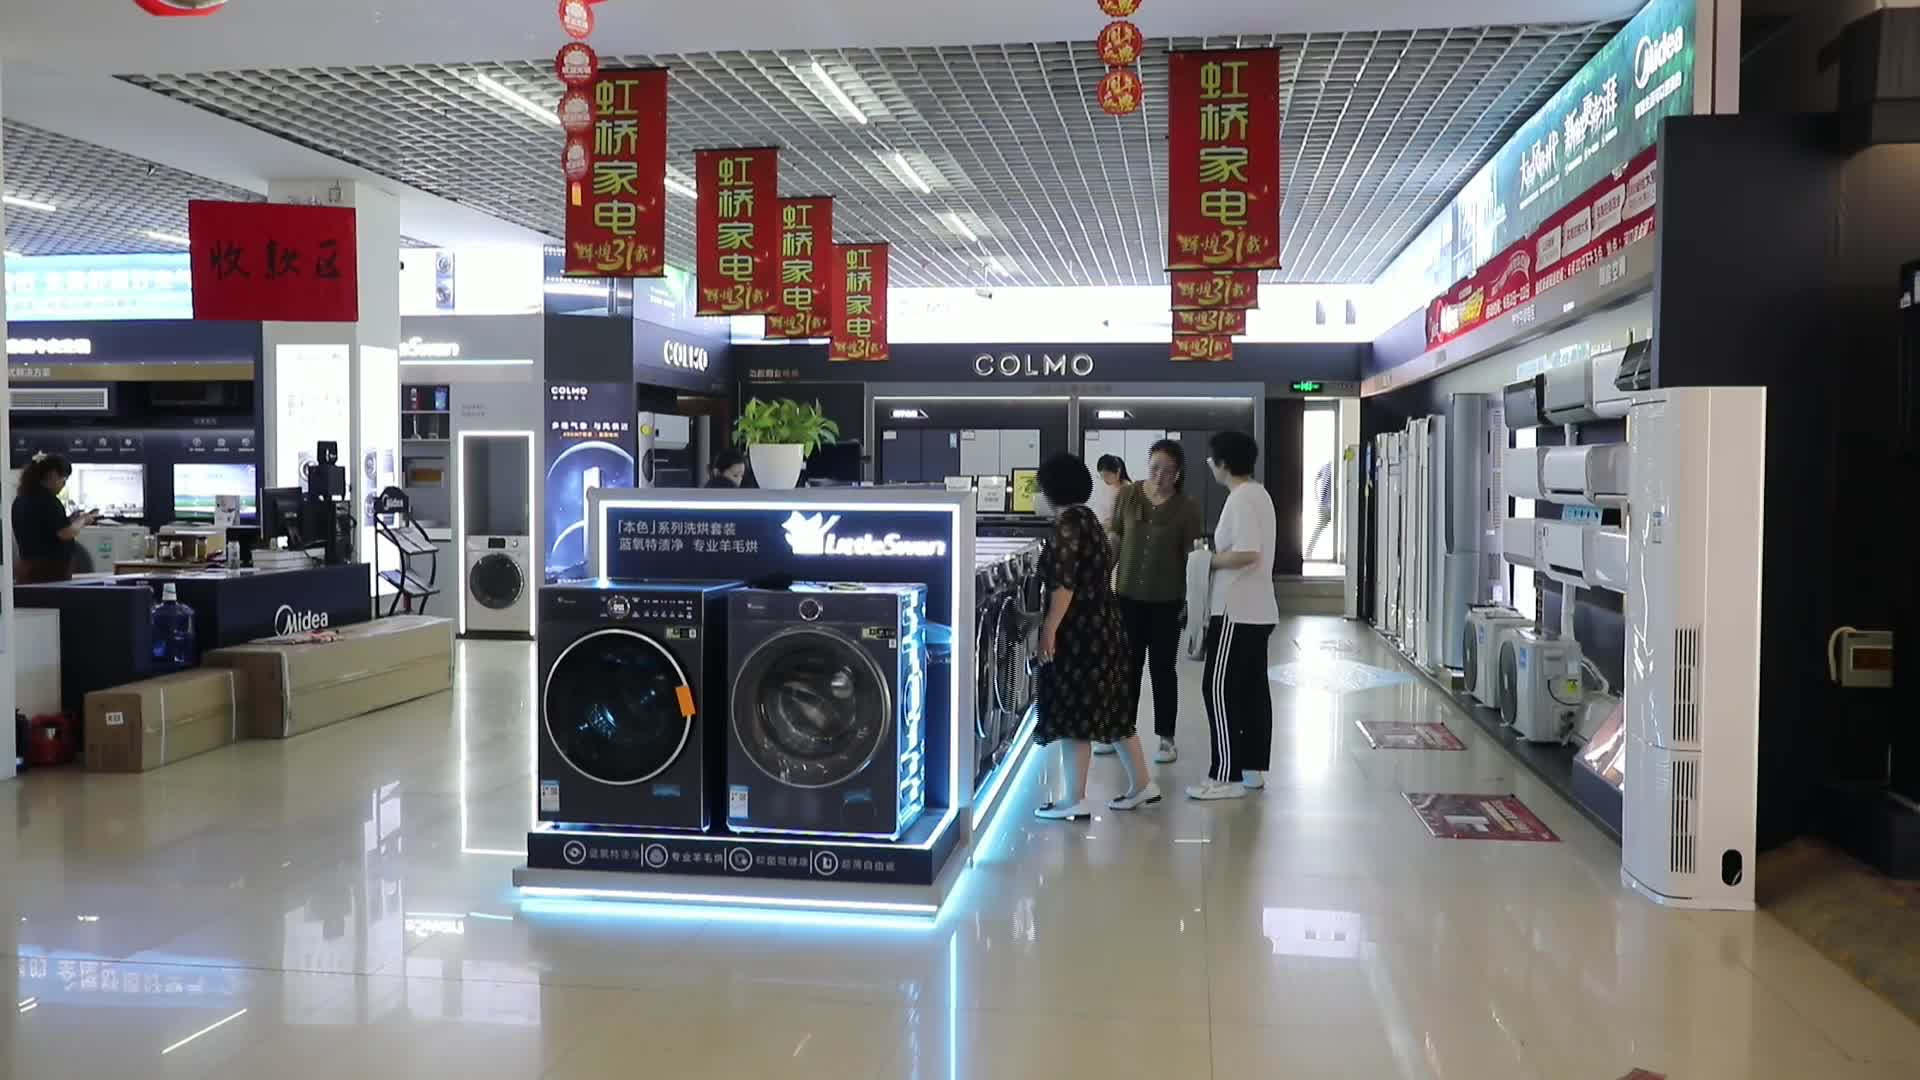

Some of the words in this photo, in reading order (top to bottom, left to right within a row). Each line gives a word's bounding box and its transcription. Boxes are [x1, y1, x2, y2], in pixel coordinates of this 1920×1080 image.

[593, 79, 639, 236] 虹桥家电
[1199, 60, 1249, 227] 虹桥家电
[717, 157, 755, 283] 虹桥家电
[210, 239, 343, 281] 收款区
[782, 204, 814, 312] 虹桥家电
[846, 249, 873, 338] 虹桥家电
[664, 340, 709, 371] COLMO
[973, 353, 1094, 377] COLMO
[550, 386, 589, 395] COLMO
[617, 520, 737, 537] 「本色」系列洗烘套装
[694, 538, 759, 554] 专业羊毛烘
[274, 604, 330, 637] Midea
